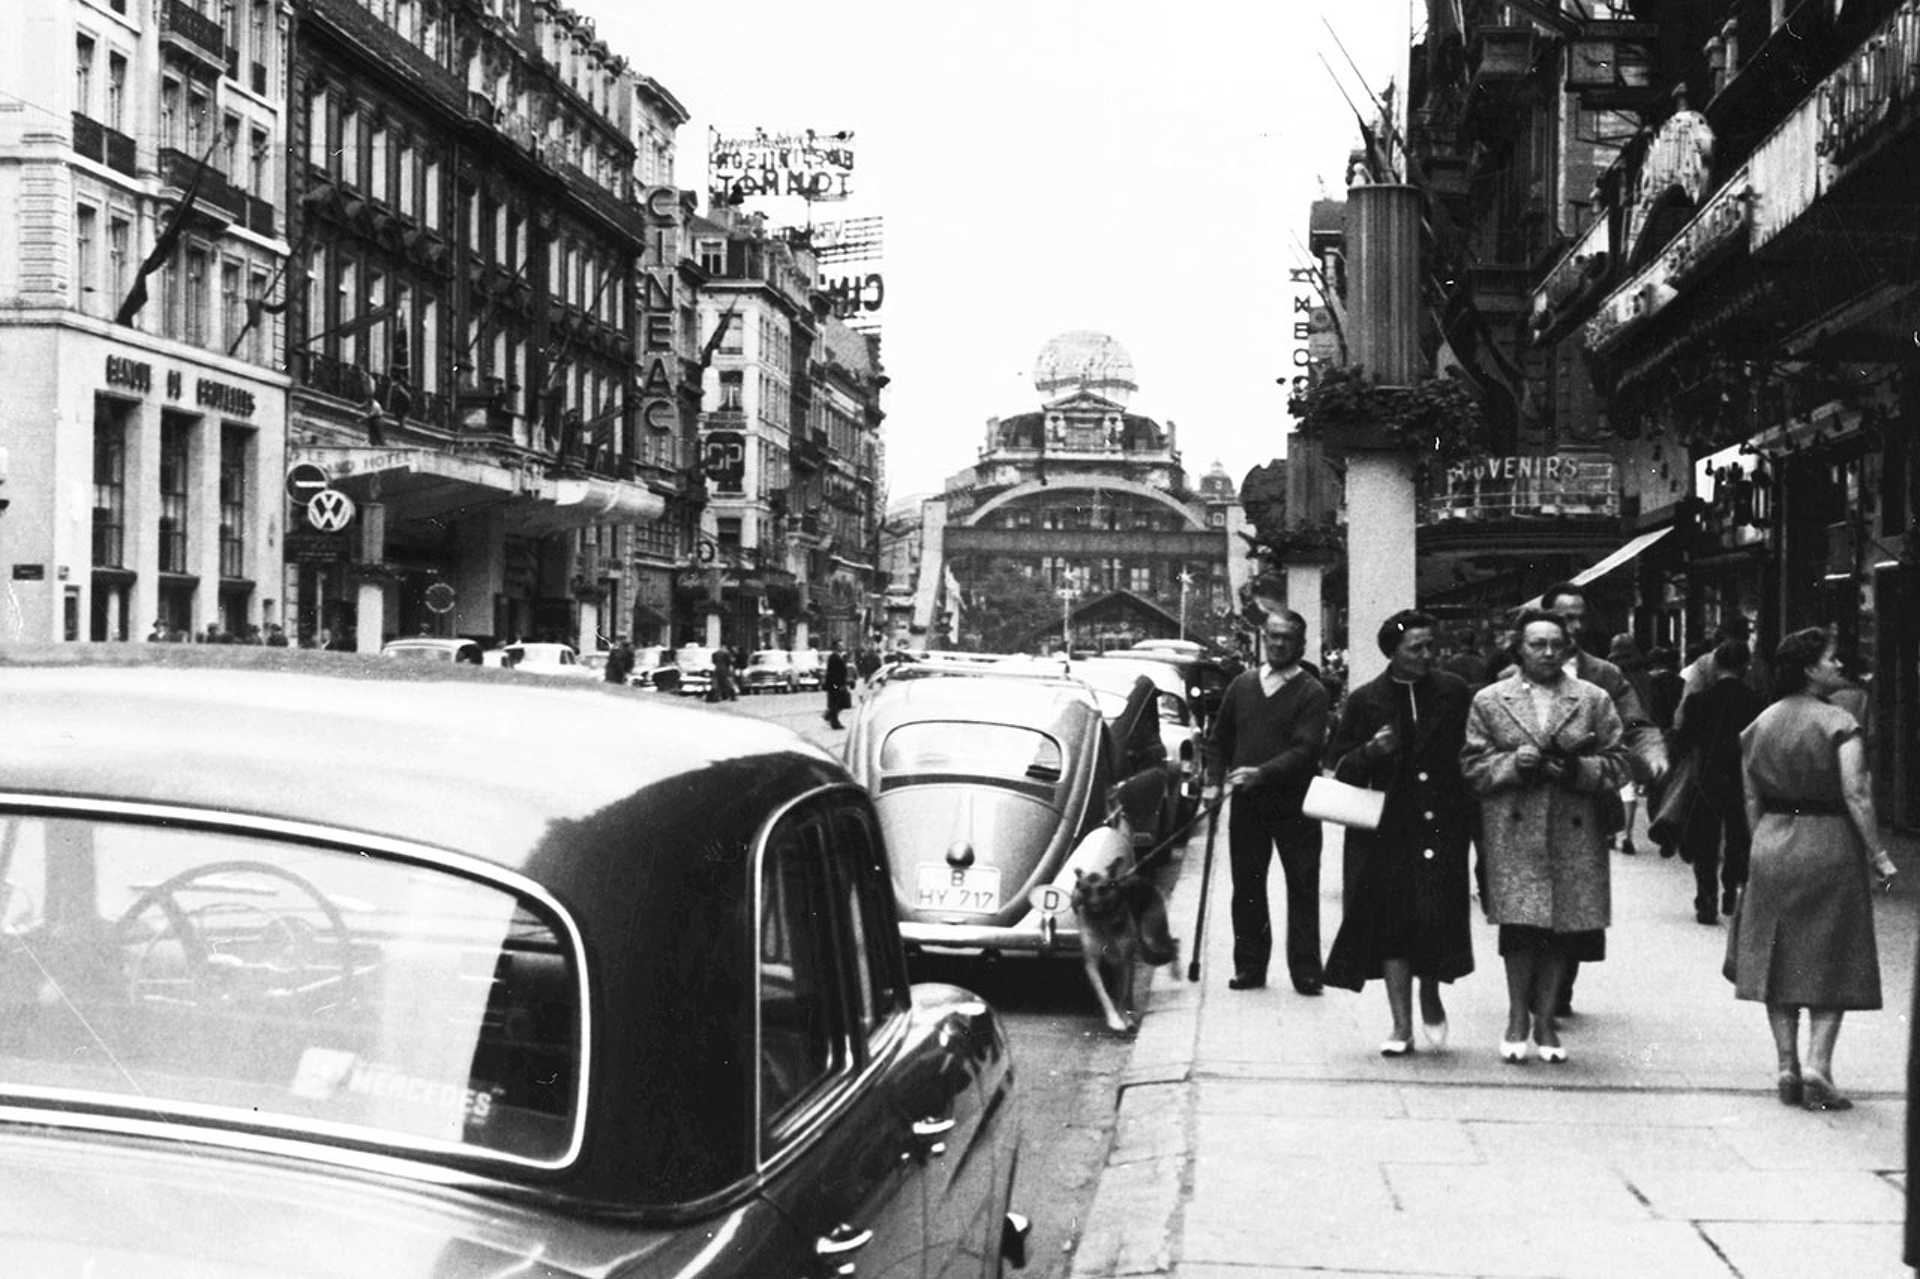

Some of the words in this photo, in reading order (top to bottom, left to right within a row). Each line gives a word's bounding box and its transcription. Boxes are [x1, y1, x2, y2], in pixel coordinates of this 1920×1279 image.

[645, 190, 675, 432] CINEAC
[952, 871, 965, 887] B
[920, 890, 948, 905] HY
[959, 891, 994, 908] 717
[1044, 890, 1059, 910] D
